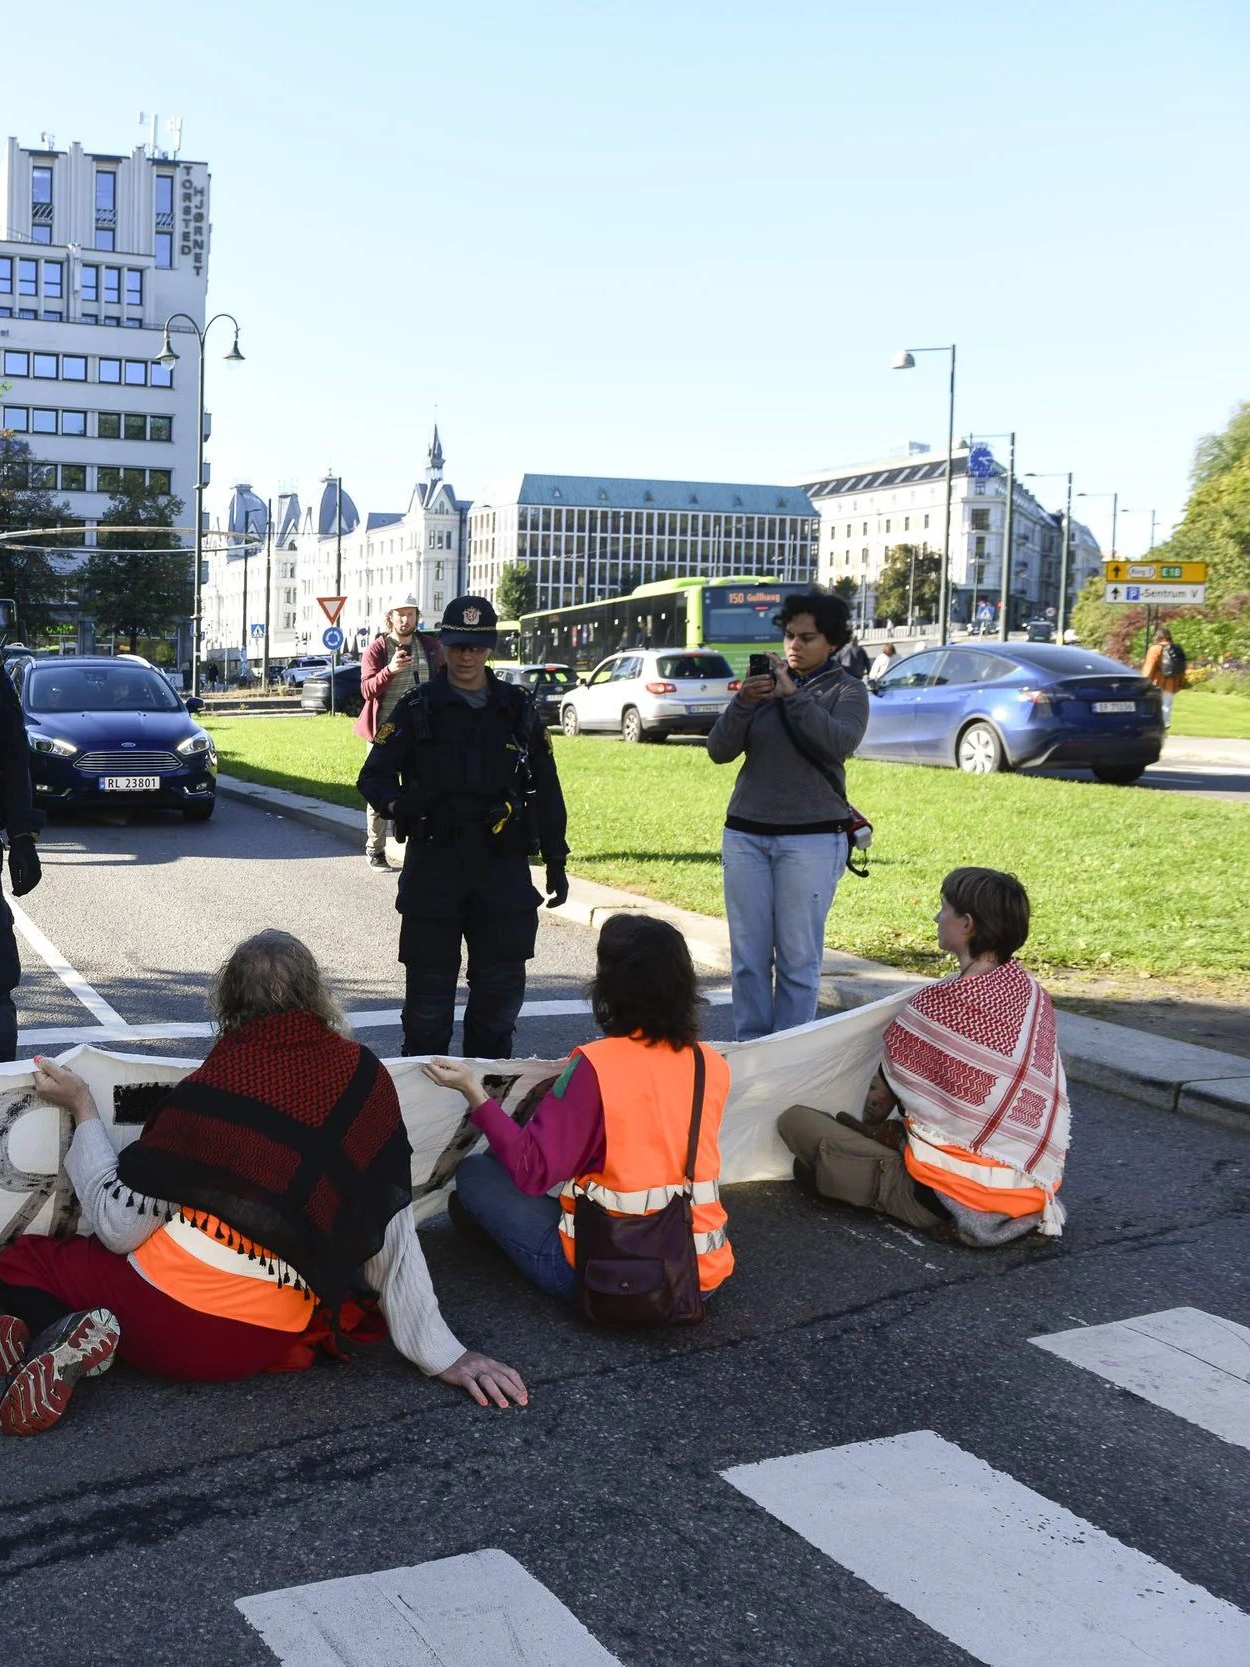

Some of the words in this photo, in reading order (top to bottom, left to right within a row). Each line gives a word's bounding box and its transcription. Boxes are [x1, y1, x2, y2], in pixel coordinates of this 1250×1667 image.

[181, 165, 193, 256] TORSTED
[193, 185, 205, 277] HJØRNET
[728, 592, 744, 604] 150
[108, 778, 120, 789] RL
[125, 778, 156, 788] 23801
